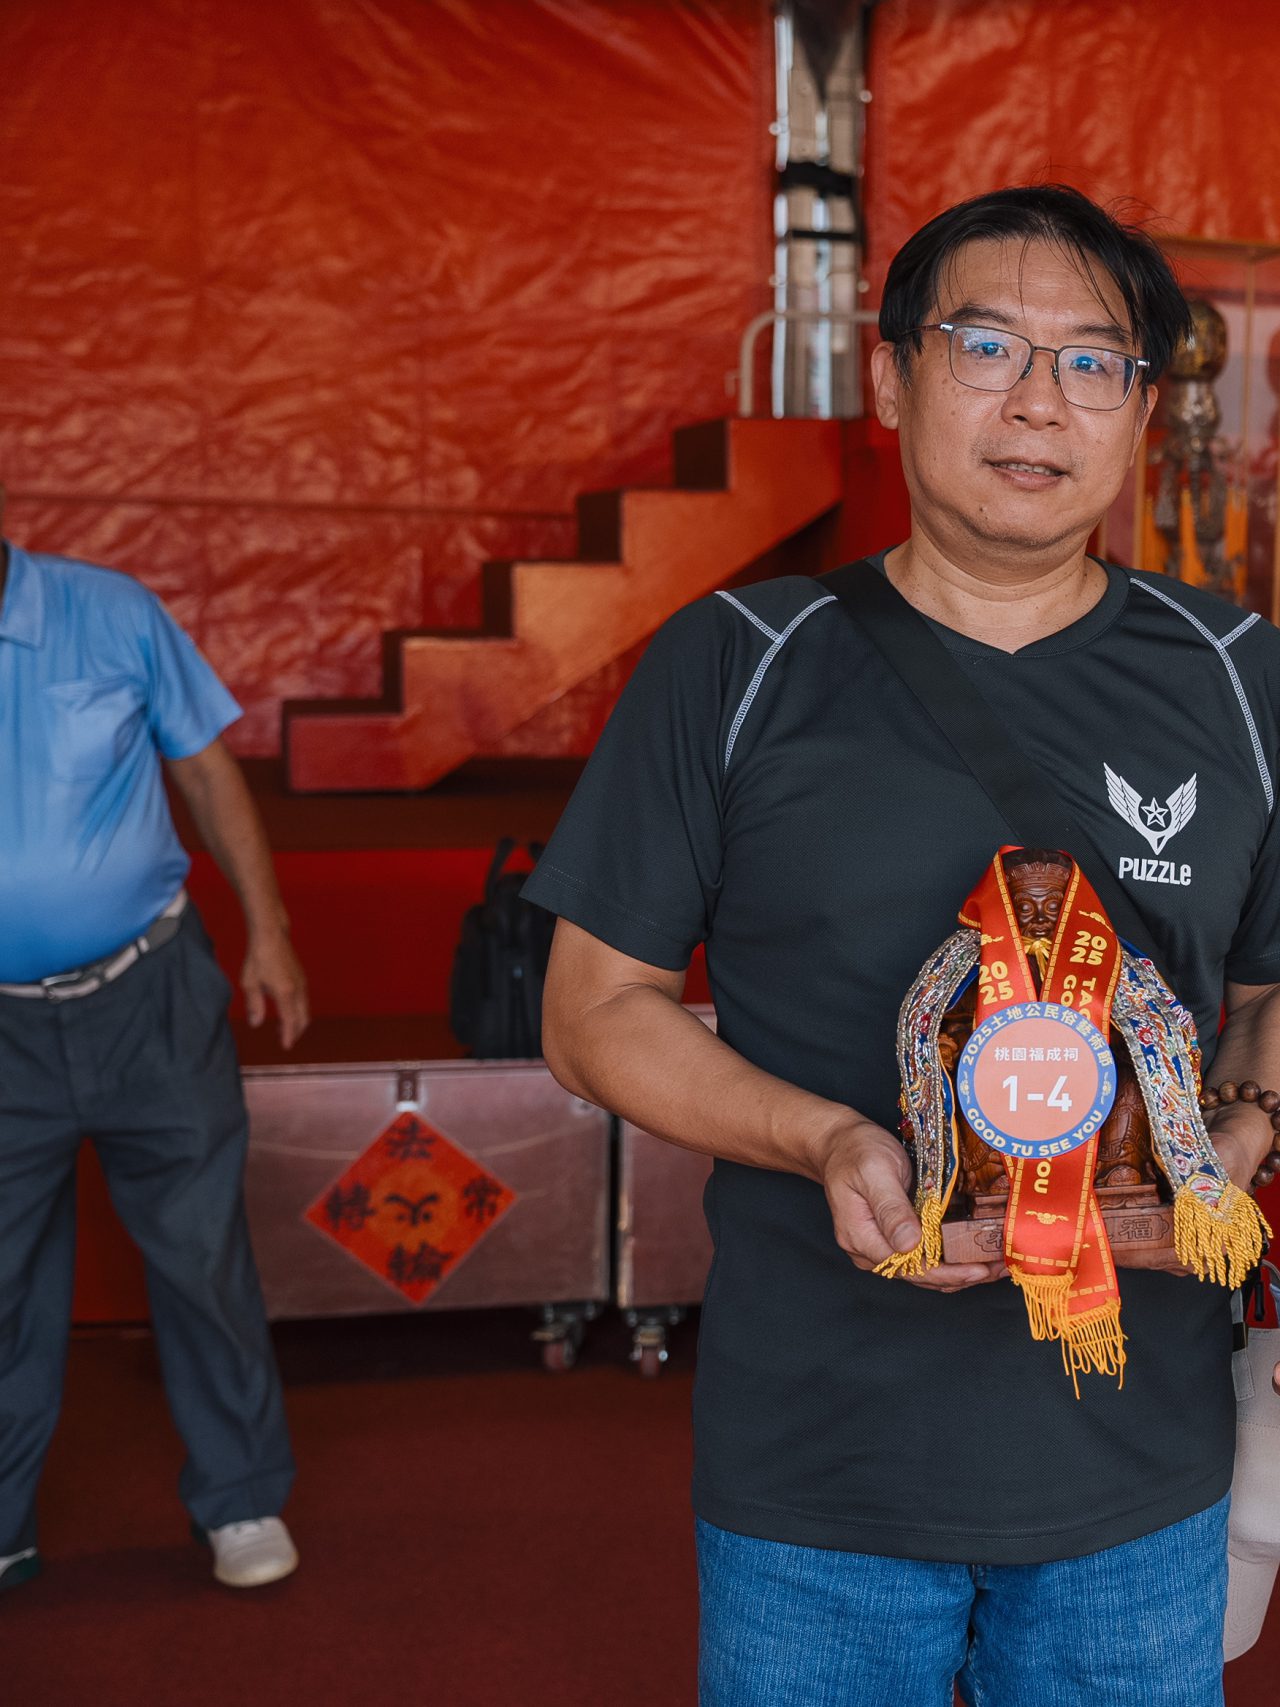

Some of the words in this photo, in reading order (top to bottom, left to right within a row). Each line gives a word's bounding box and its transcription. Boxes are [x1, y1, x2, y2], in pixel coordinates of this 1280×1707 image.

[1074, 930, 1108, 951] 20
[1070, 946, 1104, 966] 25
[979, 960, 1008, 985] 20
[979, 981, 1014, 1006] 25
[994, 1047, 1079, 1062] 桃園福成祠
[1002, 1074, 1073, 1112] 1-4
[967, 1107, 1006, 1148] GOOD
[1011, 1142, 1033, 1157] TU
[1038, 1138, 1072, 1157] SEE
[1072, 1109, 1103, 1141] YOU
[1034, 1157, 1052, 1194] OU
